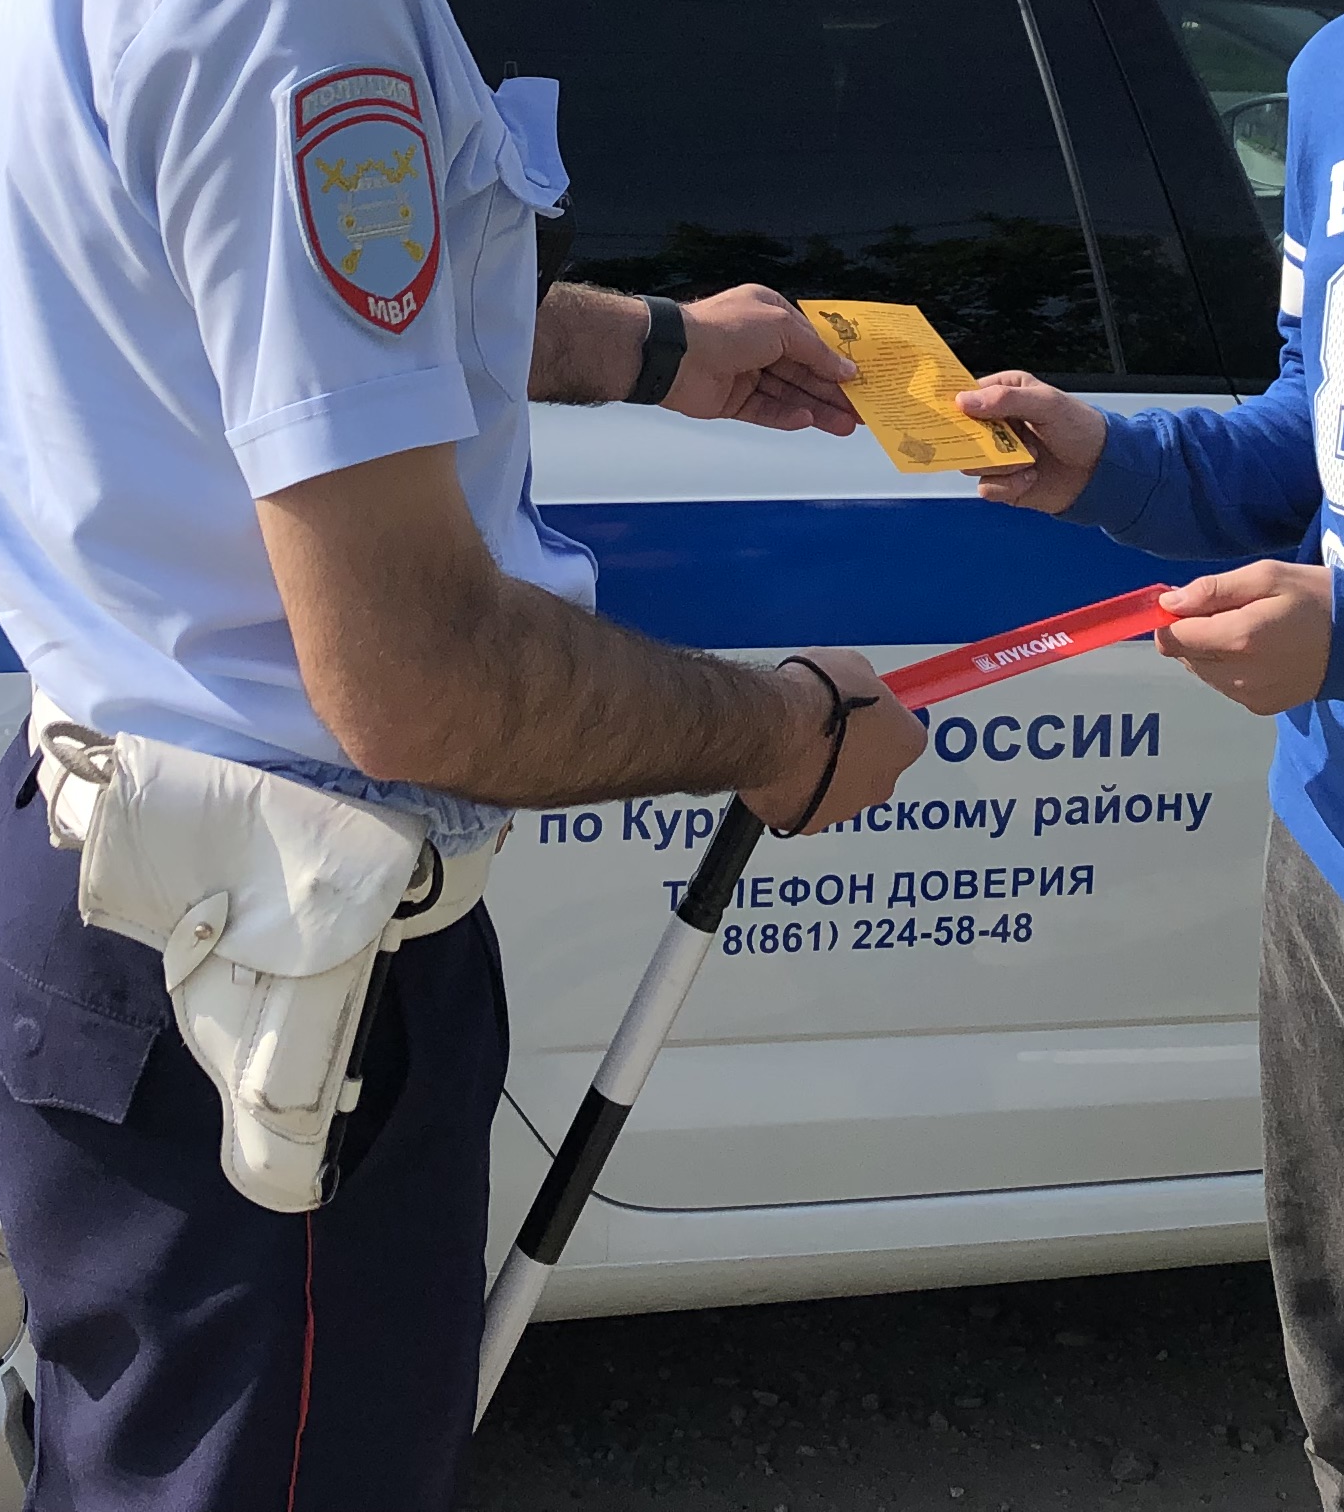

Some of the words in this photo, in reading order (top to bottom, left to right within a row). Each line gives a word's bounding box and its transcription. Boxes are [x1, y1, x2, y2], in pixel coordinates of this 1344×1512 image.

[367, 291, 417, 326] МВД
[994, 631, 1074, 666] ЛУКОЙЛ
[912, 707, 1161, 763] ОССИИ
[540, 811, 604, 845] по
[1034, 783, 1213, 837] району
[662, 873, 875, 912] ТЕФОН
[887, 864, 1095, 909] ДОВЕРИЯ
[722, 920, 840, 956] 8(861)
[852, 913, 1033, 951] 224-58-48
